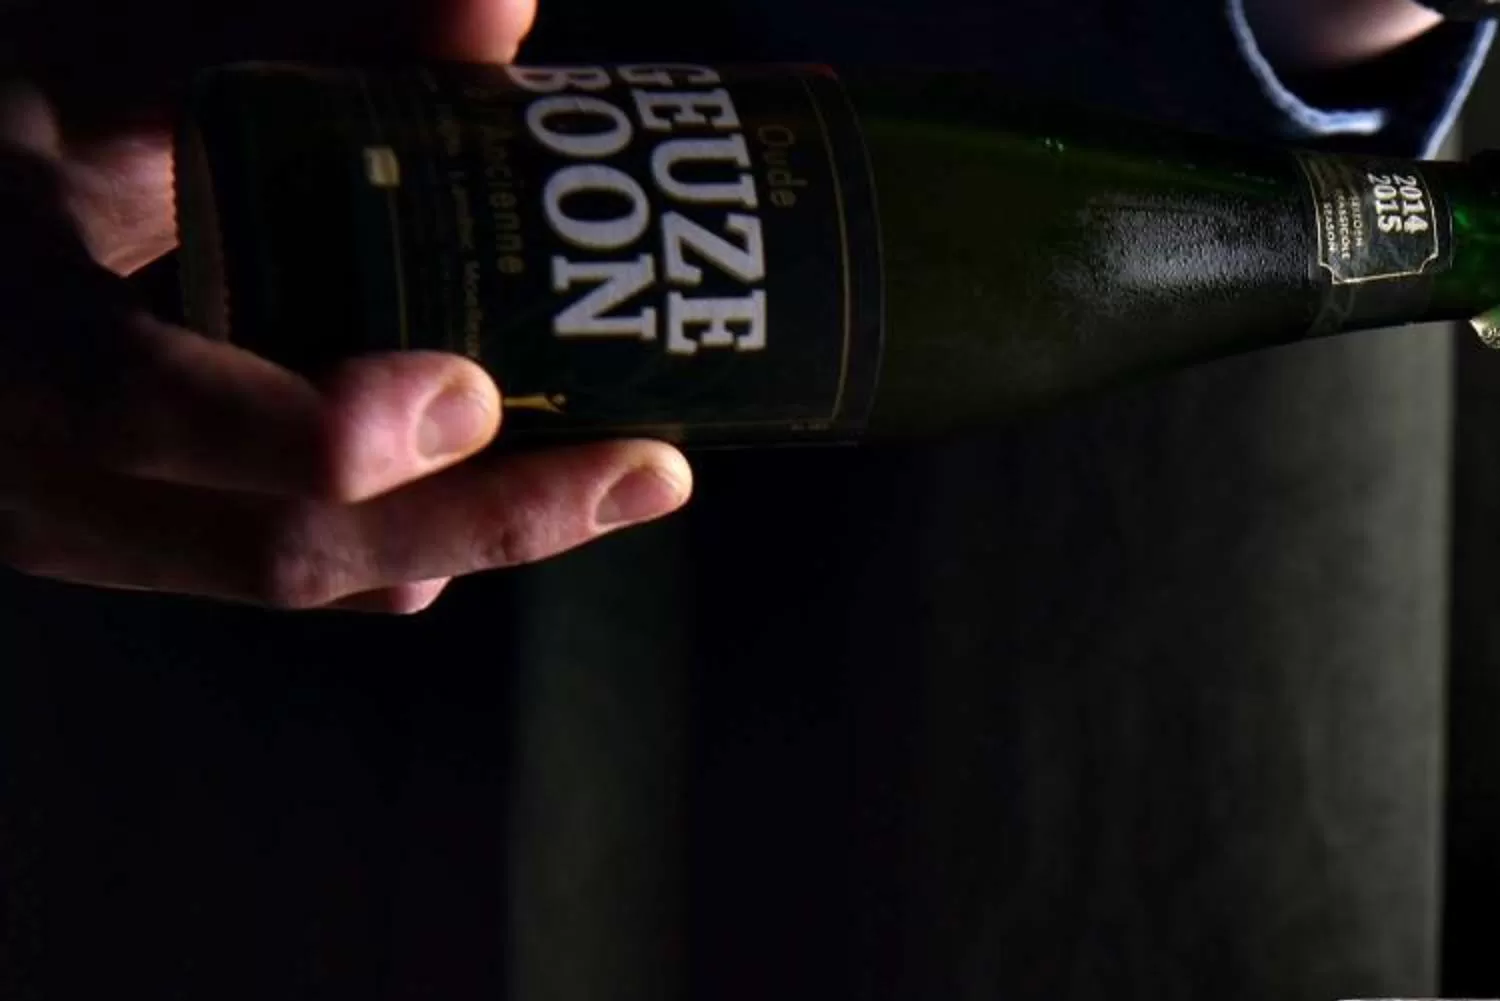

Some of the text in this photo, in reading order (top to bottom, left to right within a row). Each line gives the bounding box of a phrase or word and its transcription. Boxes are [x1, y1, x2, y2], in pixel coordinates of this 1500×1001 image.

[504, 63, 659, 342] BOON
[616, 61, 768, 356] GEUZE
[757, 124, 808, 209] Oude
[1366, 171, 1403, 234] 2015
[1391, 171, 1429, 235] 2014
